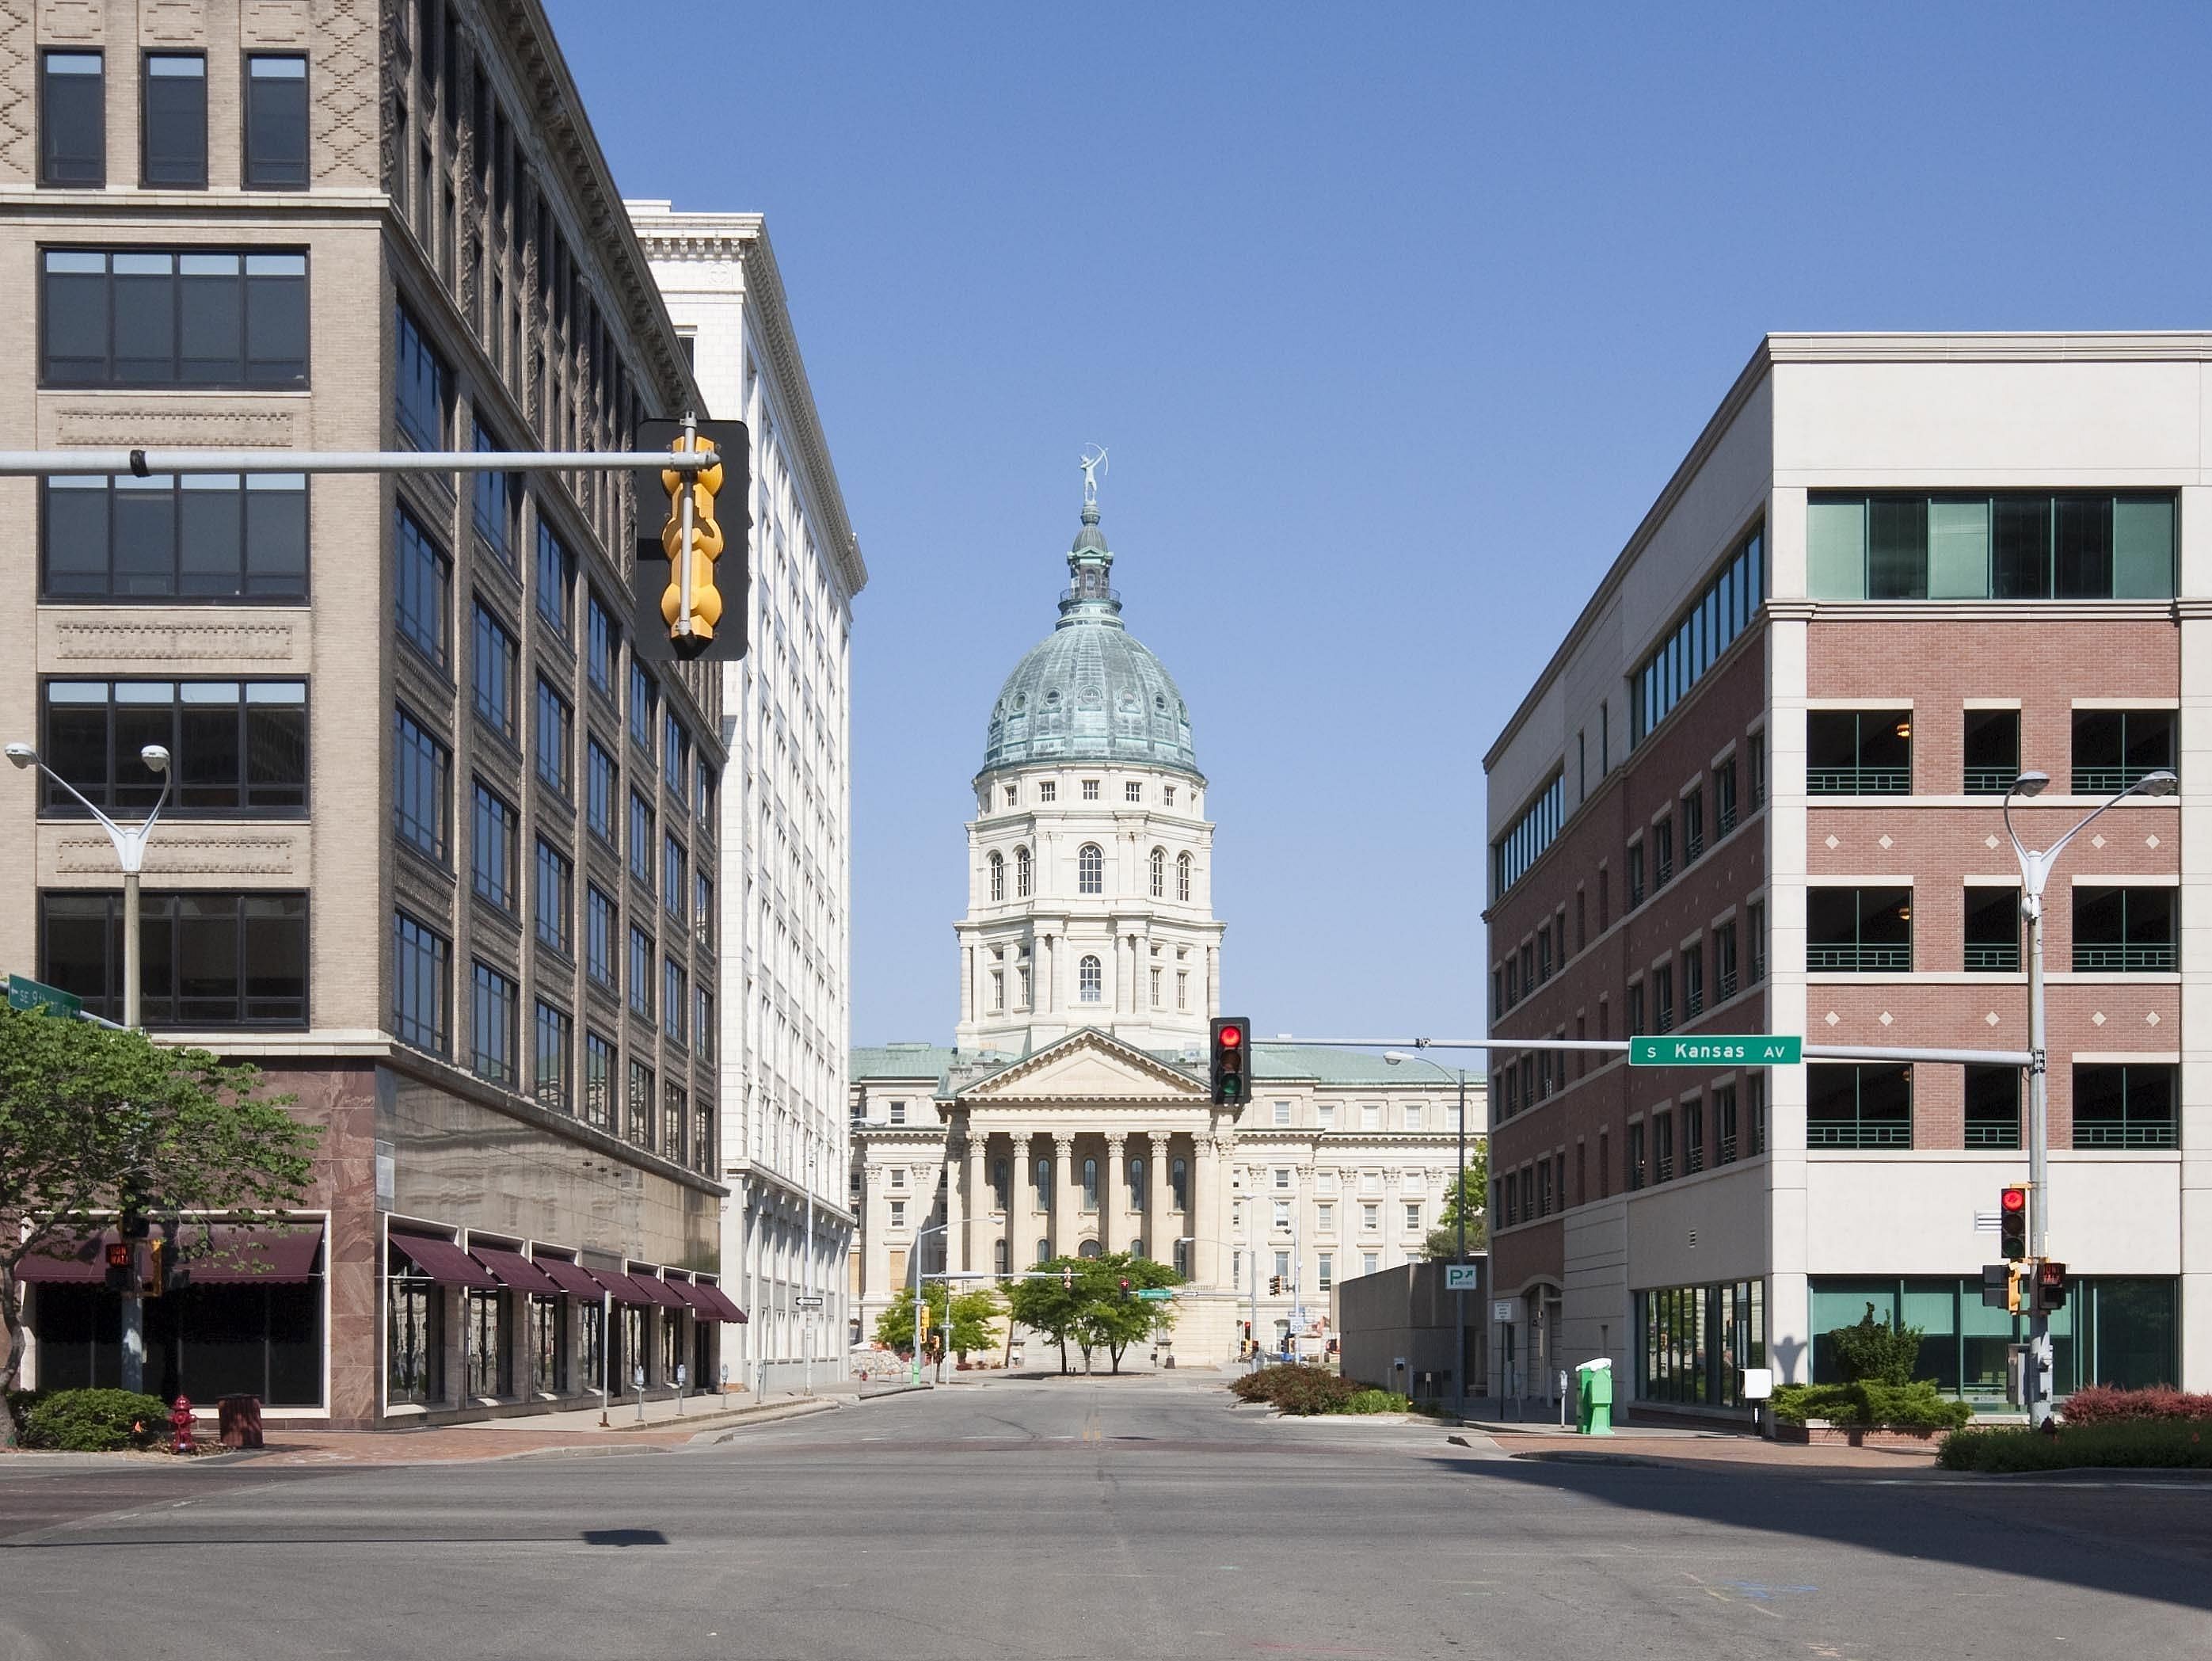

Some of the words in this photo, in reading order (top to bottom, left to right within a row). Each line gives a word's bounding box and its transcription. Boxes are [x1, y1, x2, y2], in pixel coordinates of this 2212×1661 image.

[1647, 1046, 1657, 1059] S
[1674, 1043, 1745, 1058] Kansas
[1763, 1046, 1785, 1058] AV
